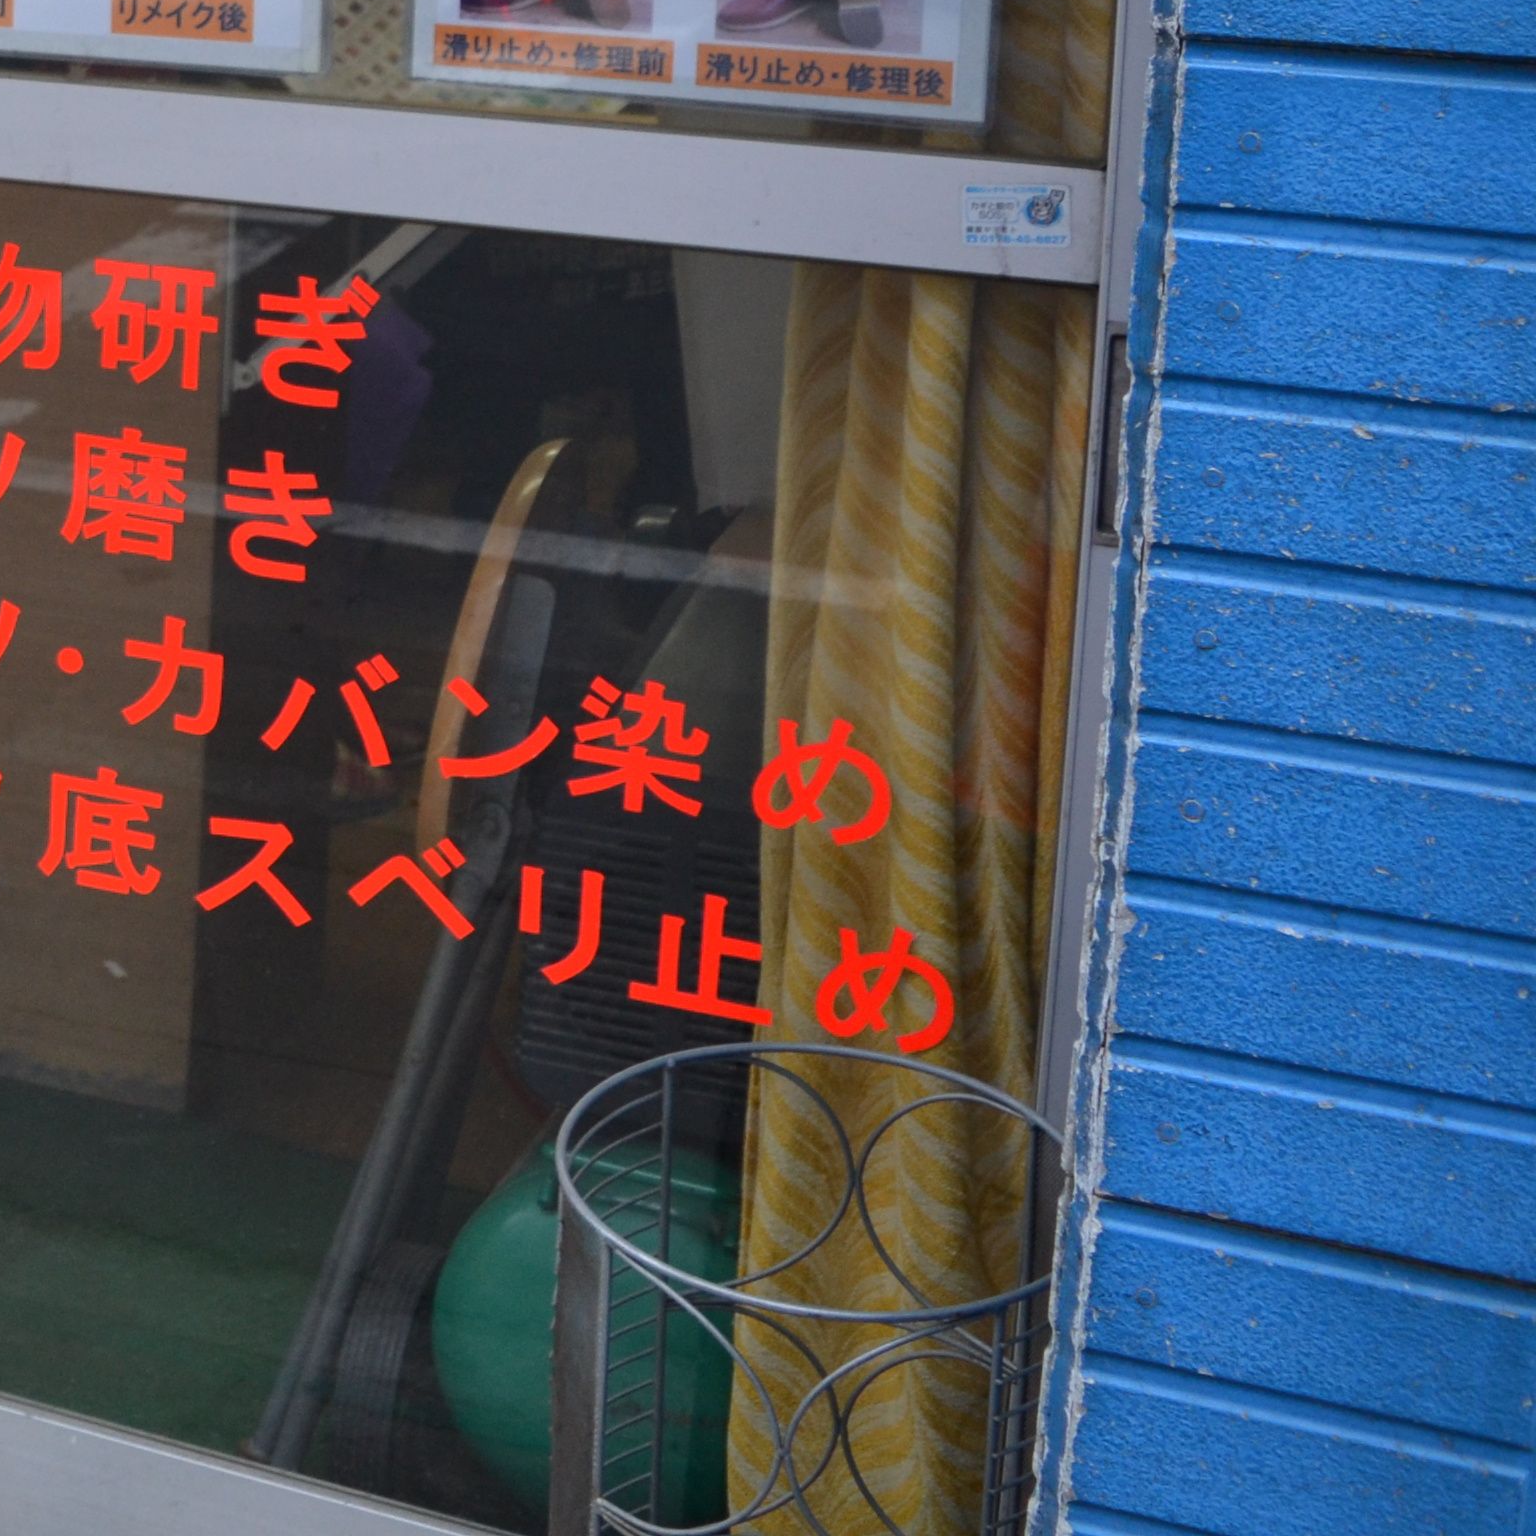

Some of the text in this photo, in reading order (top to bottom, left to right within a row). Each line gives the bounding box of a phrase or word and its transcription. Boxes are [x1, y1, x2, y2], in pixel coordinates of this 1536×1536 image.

[442, 32, 667, 78] 滑り止め・修理前
[706, 52, 945, 99] 滑り止め・修理後
